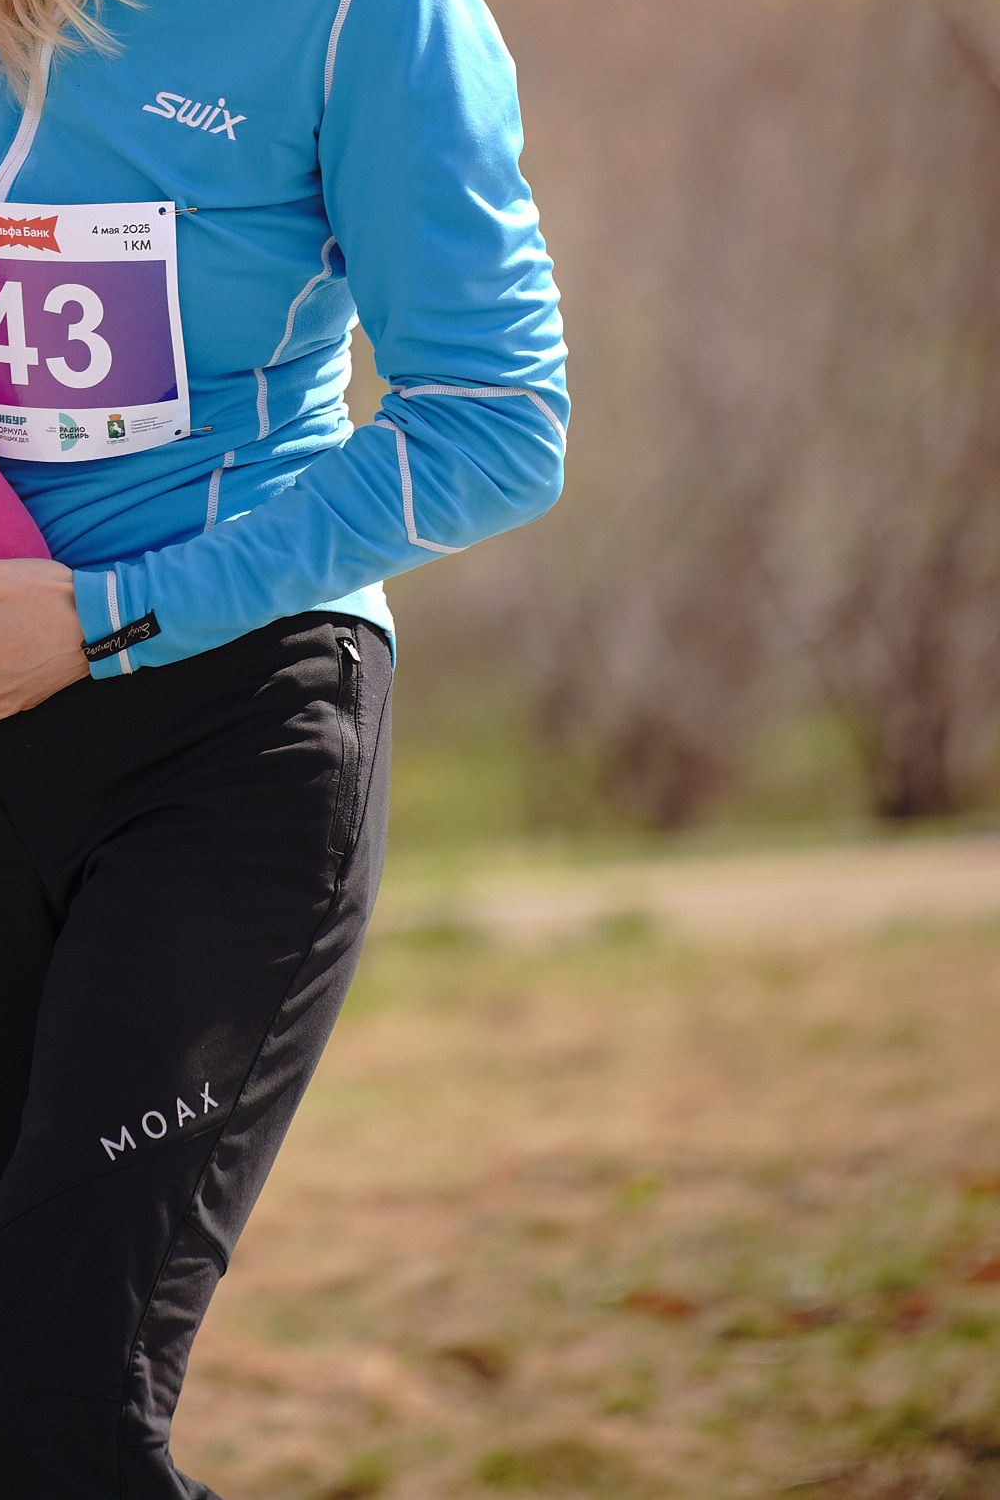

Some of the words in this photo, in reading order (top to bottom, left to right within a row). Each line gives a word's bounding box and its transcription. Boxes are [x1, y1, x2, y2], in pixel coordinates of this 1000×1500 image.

[23, 226, 50, 239] Банк
[92, 226, 99, 236] 4
[100, 227, 120, 236] мая
[122, 224, 151, 235] 2025
[124, 240, 129, 251] 1
[100, 1081, 219, 1161] MOAX
